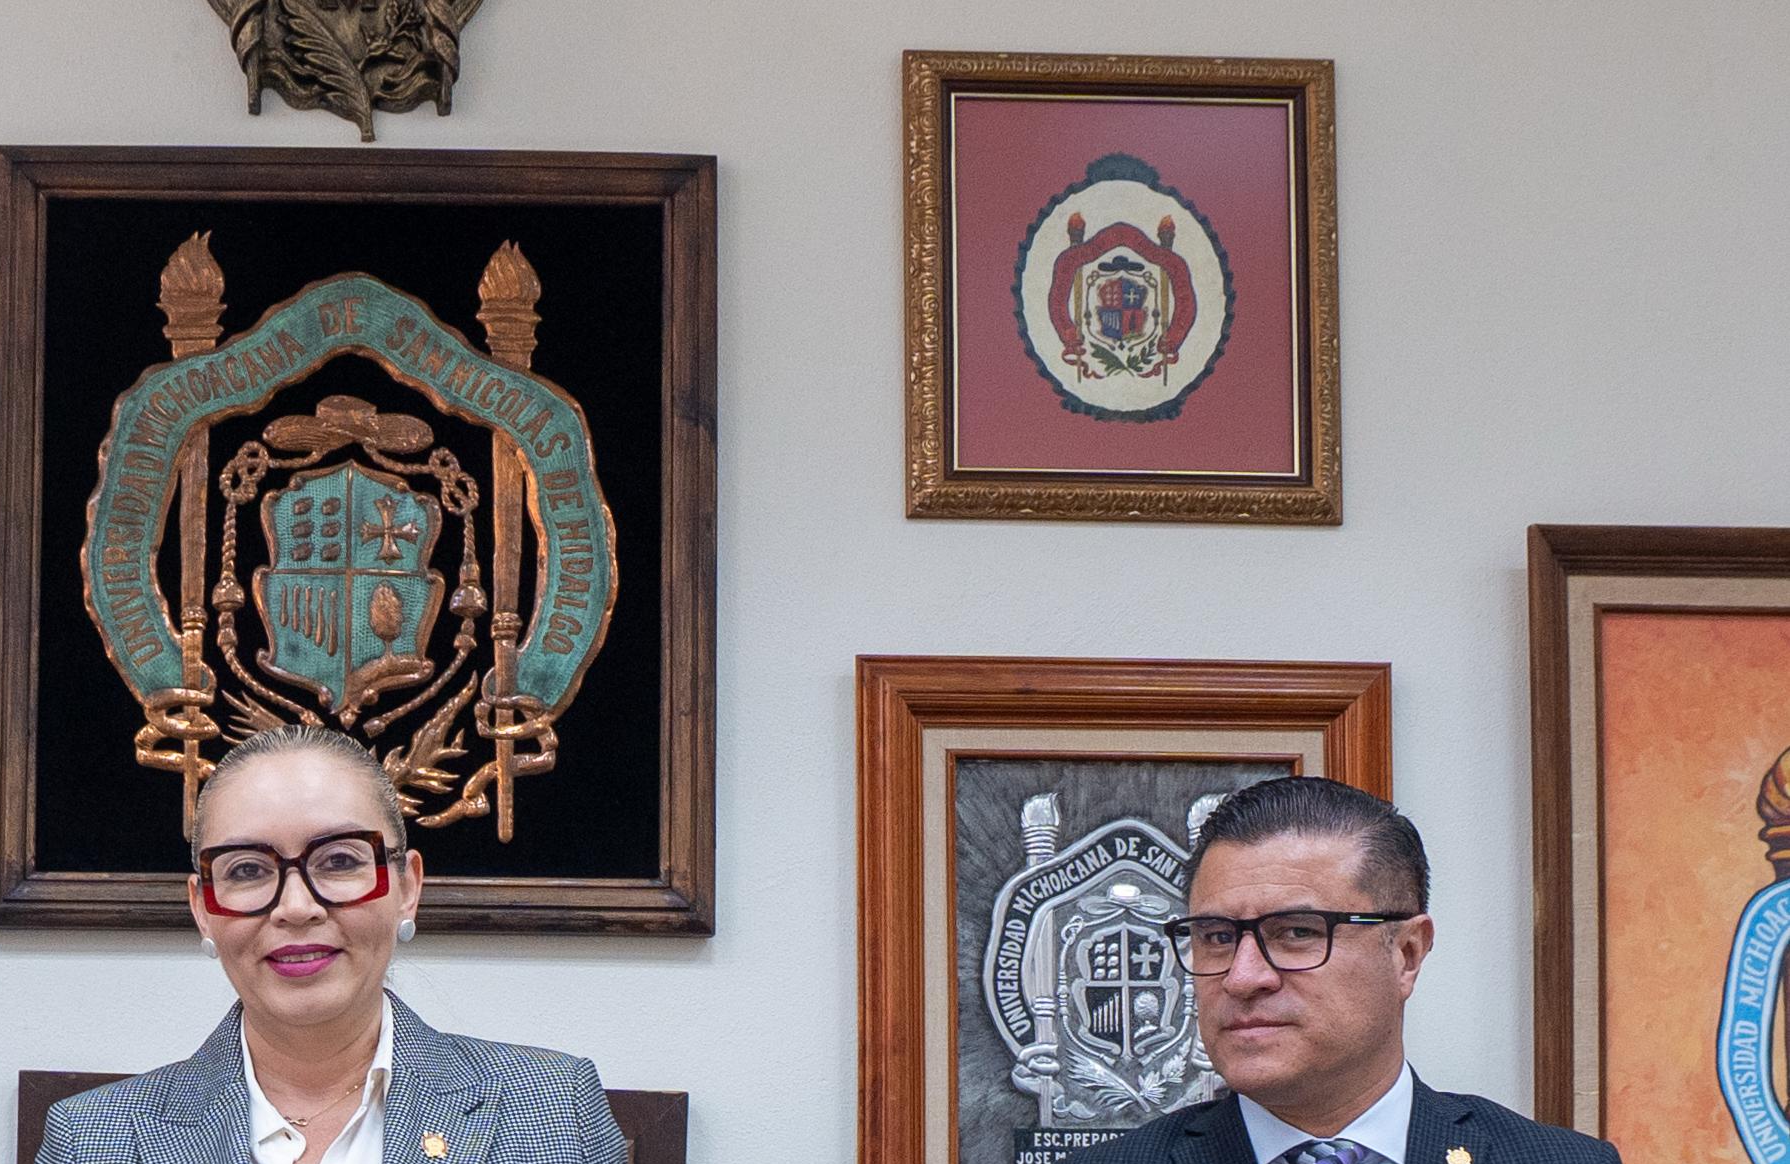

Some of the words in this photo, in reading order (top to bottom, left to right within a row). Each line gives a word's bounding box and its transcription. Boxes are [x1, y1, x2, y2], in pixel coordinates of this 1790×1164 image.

[318, 297, 366, 337] DE
[384, 314, 444, 377] SAN
[138, 328, 306, 452] MICHOACANA
[443, 358, 573, 461] NICOLAS
[543, 469, 584, 513] DE
[103, 448, 166, 668] UNIVERSIDAD
[542, 513, 595, 658] HIDALGO
[1012, 844, 1112, 913] MICHOACANA
[1115, 836, 1140, 860] DE
[1140, 846, 1178, 878] SAN
[997, 918, 1031, 1036] UNIVERSIDAD
[1734, 1019, 1787, 1163] UNIVERSIDAD
[1016, 1152, 1051, 1164] JOSE
[1055, 1152, 1073, 1161] M
[1034, 1133, 1125, 1148] ESC.PREPA
